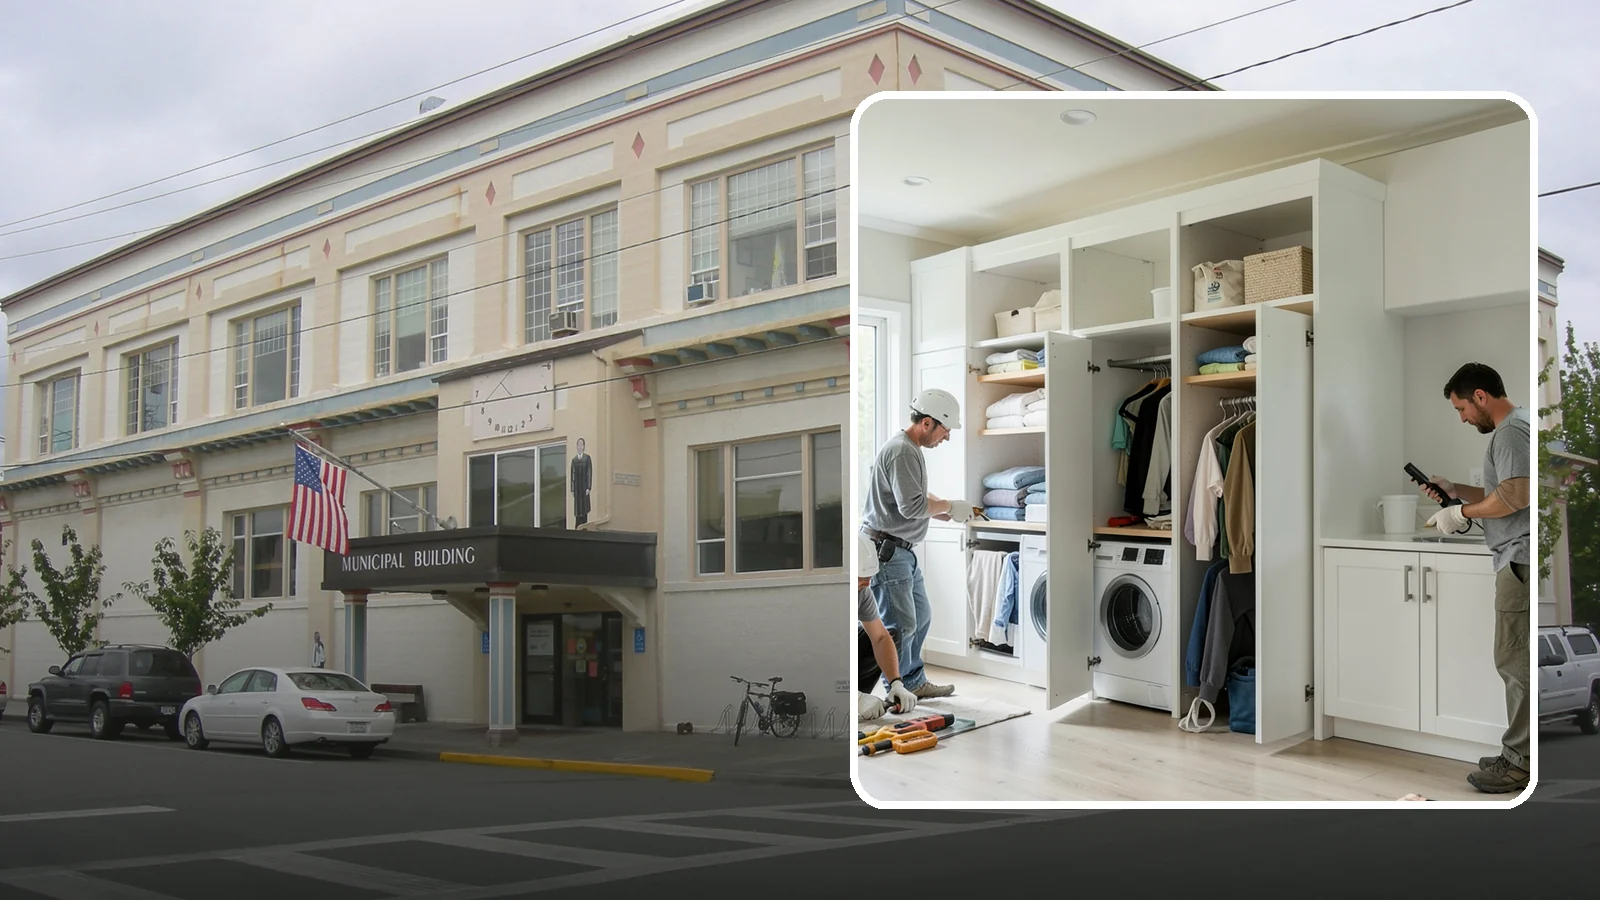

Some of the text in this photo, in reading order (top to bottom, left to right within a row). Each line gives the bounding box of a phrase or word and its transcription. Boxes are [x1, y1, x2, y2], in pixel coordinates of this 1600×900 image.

[480, 406, 485, 415] 8
[488, 417, 492, 426] 9
[494, 424, 500, 432] 10
[502, 426, 506, 434] 11
[508, 425, 514, 434] 12
[521, 420, 526, 428] 2
[528, 414, 533, 422] 3
[536, 402, 540, 410] 4
[546, 362, 552, 370] 6
[342, 546, 476, 572] MUNICIPAL BUILDING
